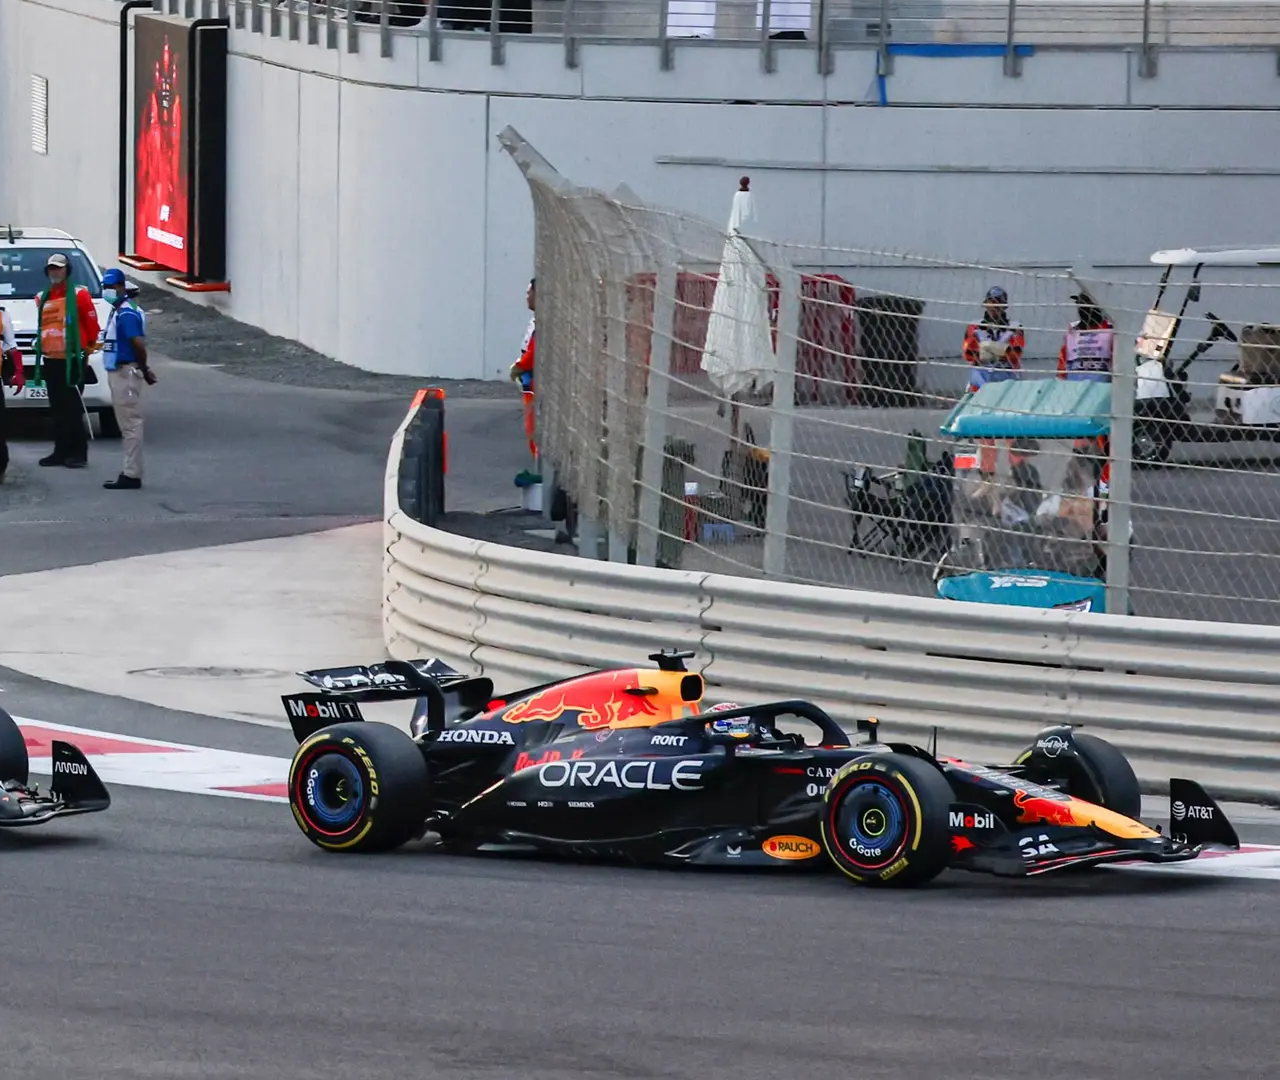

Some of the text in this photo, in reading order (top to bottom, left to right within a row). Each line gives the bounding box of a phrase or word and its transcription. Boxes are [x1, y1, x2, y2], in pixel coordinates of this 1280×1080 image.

[288, 699, 354, 720] Mobil 1
[436, 729, 514, 746] HONDA
[651, 734, 688, 746] ROKT
[1036, 740, 1070, 750] Hard Rock
[354, 746, 379, 796] ZERO
[540, 760, 704, 790] ORACLE
[806, 768, 835, 778] CAR
[568, 800, 594, 808] SIEMENS
[1188, 806, 1214, 820] AT&T
[949, 812, 994, 830] Mobil
[778, 842, 813, 854] RAUCH
[856, 844, 882, 857] Gate
